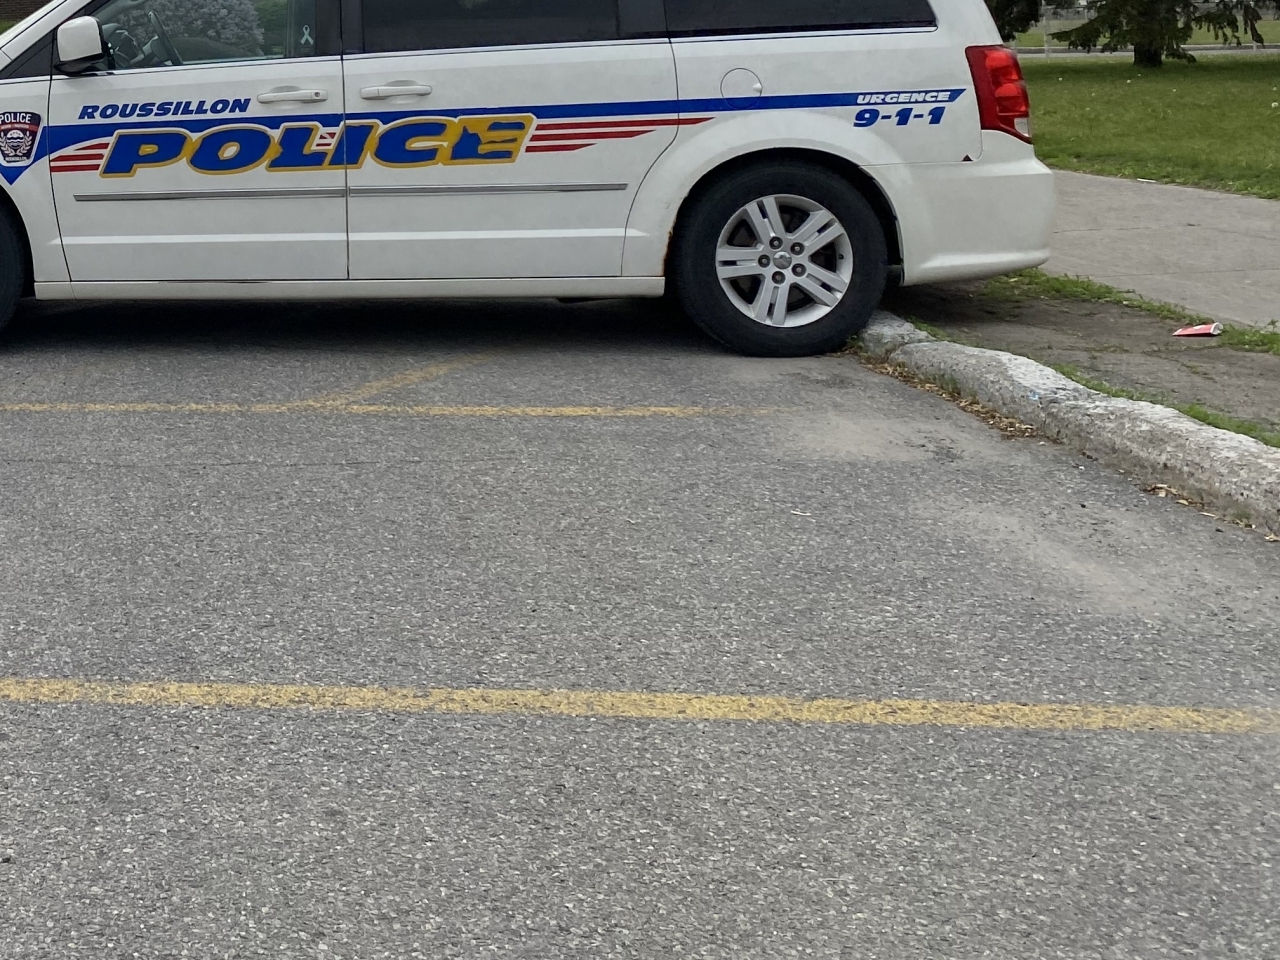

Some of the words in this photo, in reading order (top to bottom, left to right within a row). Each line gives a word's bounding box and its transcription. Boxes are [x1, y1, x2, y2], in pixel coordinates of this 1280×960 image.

[856, 91, 951, 104] URGENCE
[78, 98, 252, 120] ROUSSILLON
[853, 106, 946, 128] 9-1-1
[101, 114, 534, 177] POLICE
